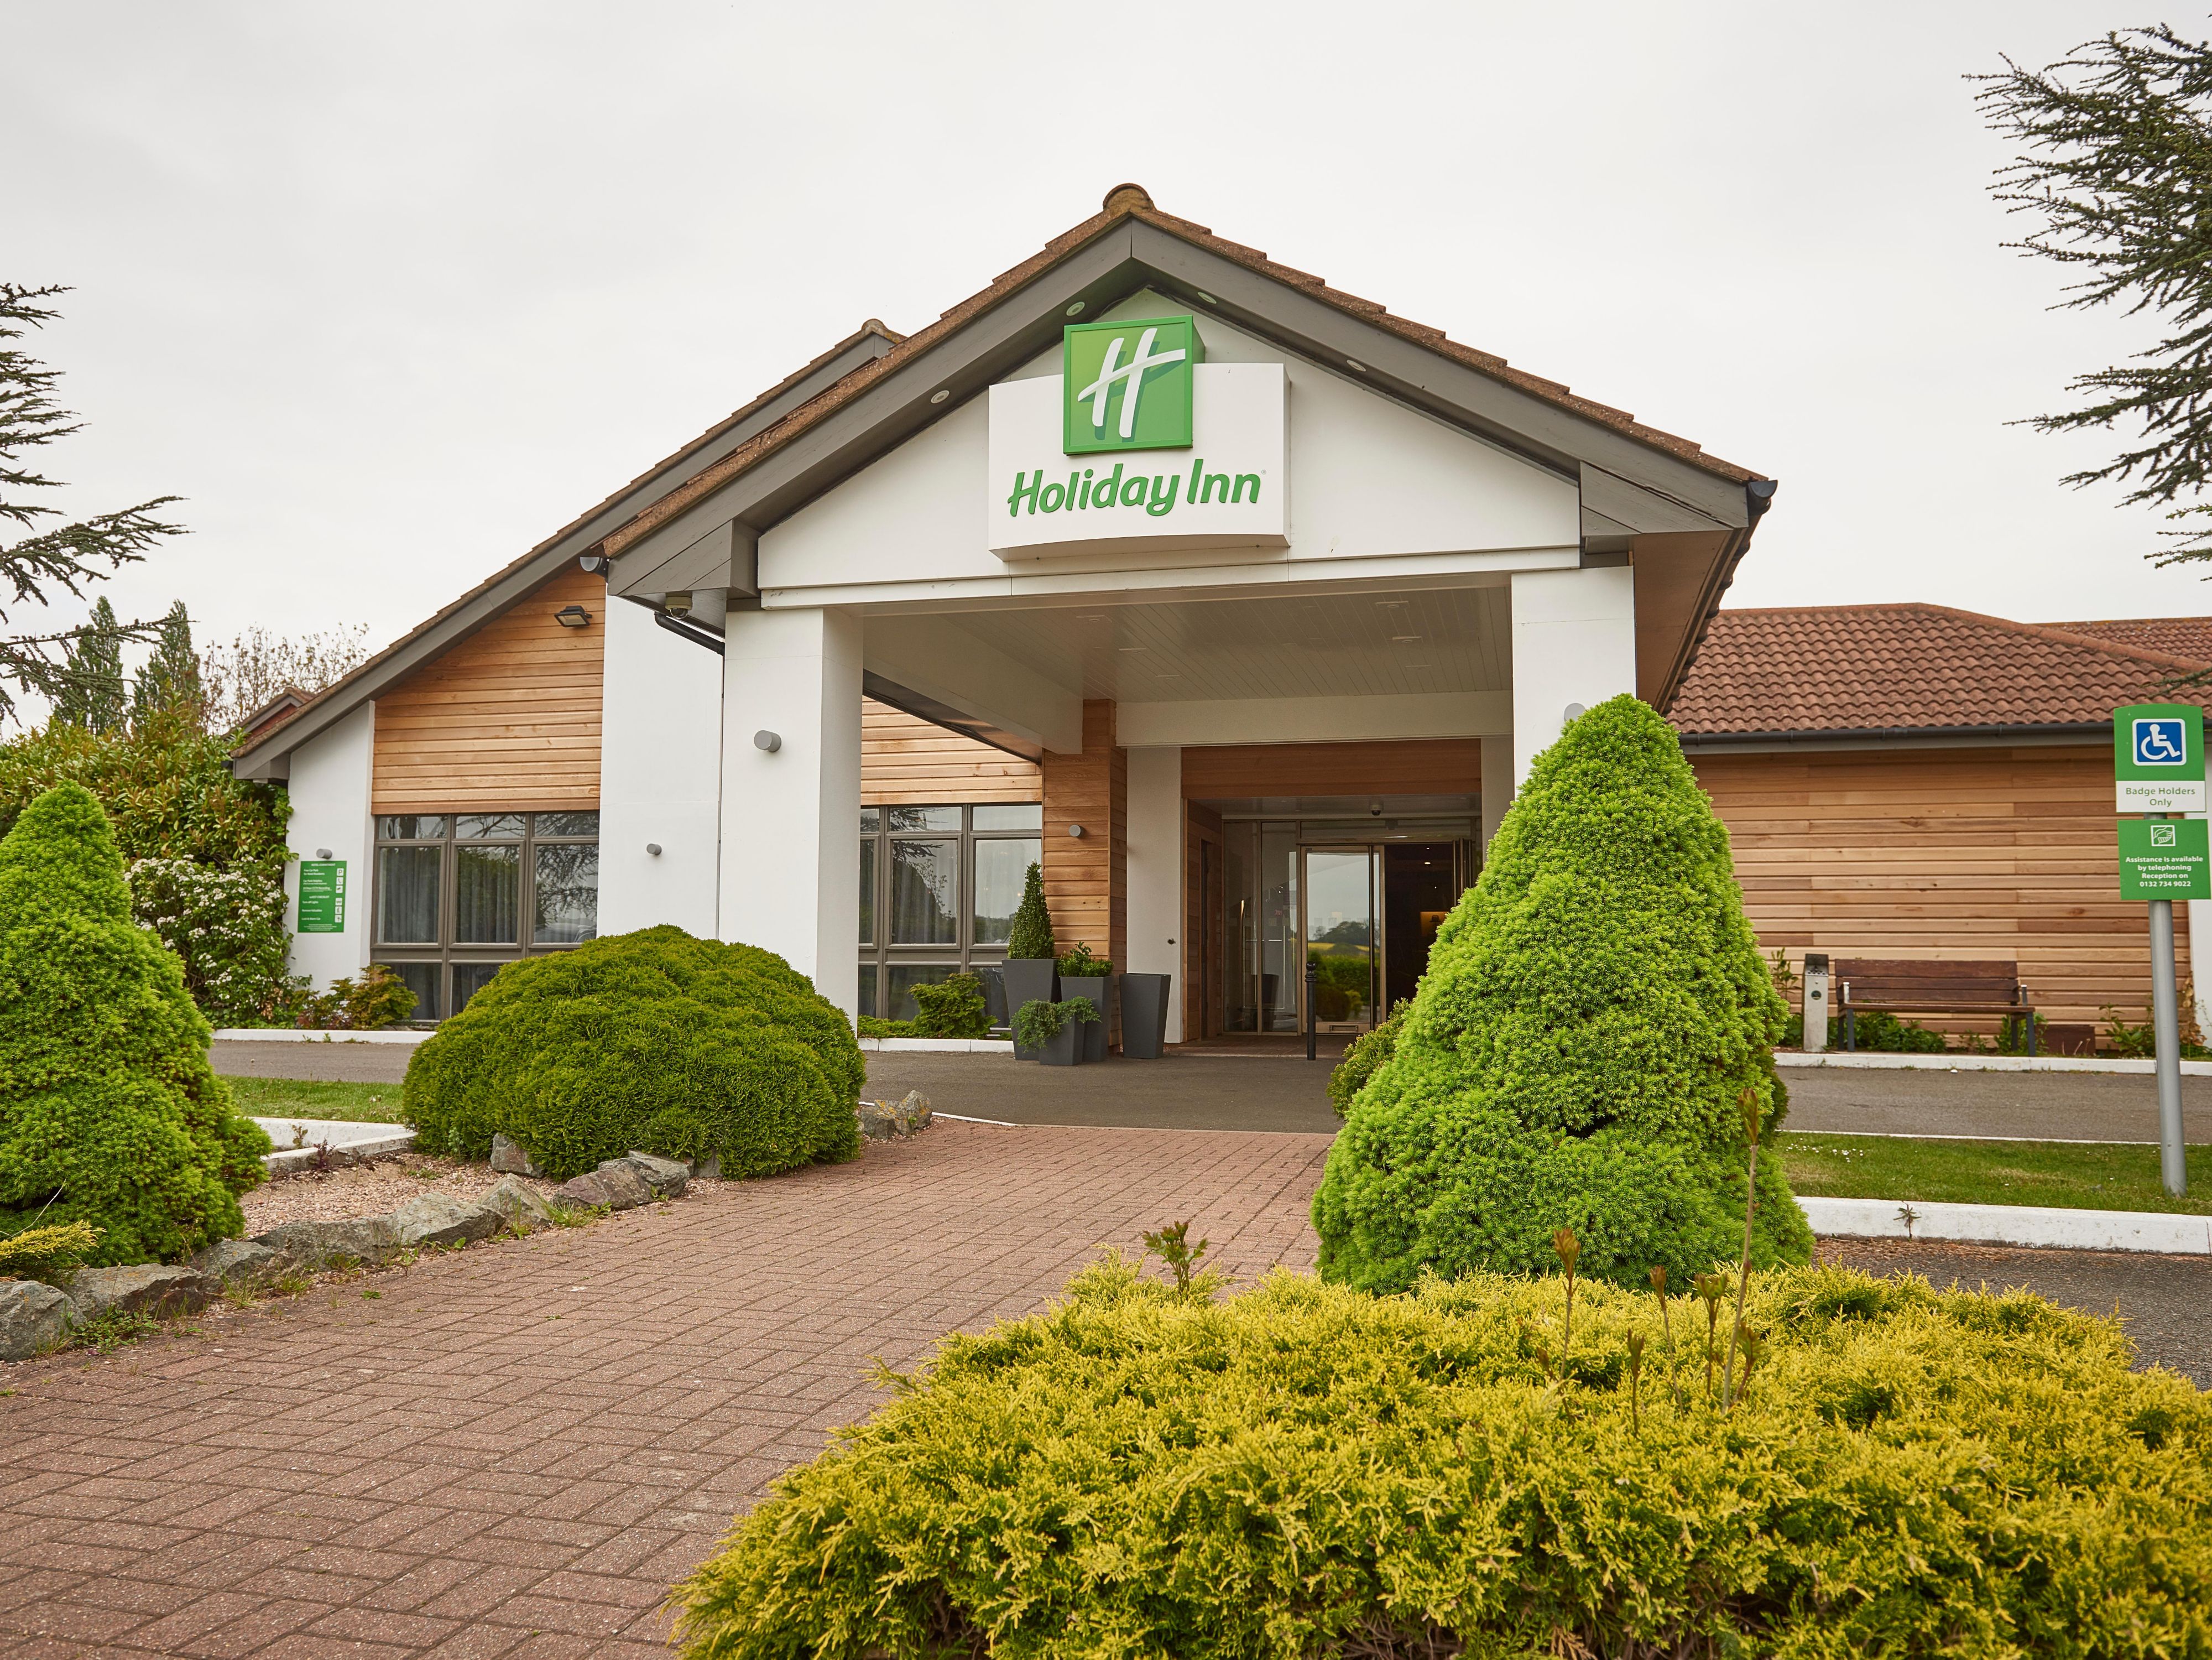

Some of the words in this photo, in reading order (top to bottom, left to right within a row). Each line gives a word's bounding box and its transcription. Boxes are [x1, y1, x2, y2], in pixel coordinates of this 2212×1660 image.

[1007, 464, 1180, 517] Holiday
[1187, 459, 1261, 504] Inn
[2126, 787, 2156, 797] Badge
[2150, 798, 2172, 808] Only
